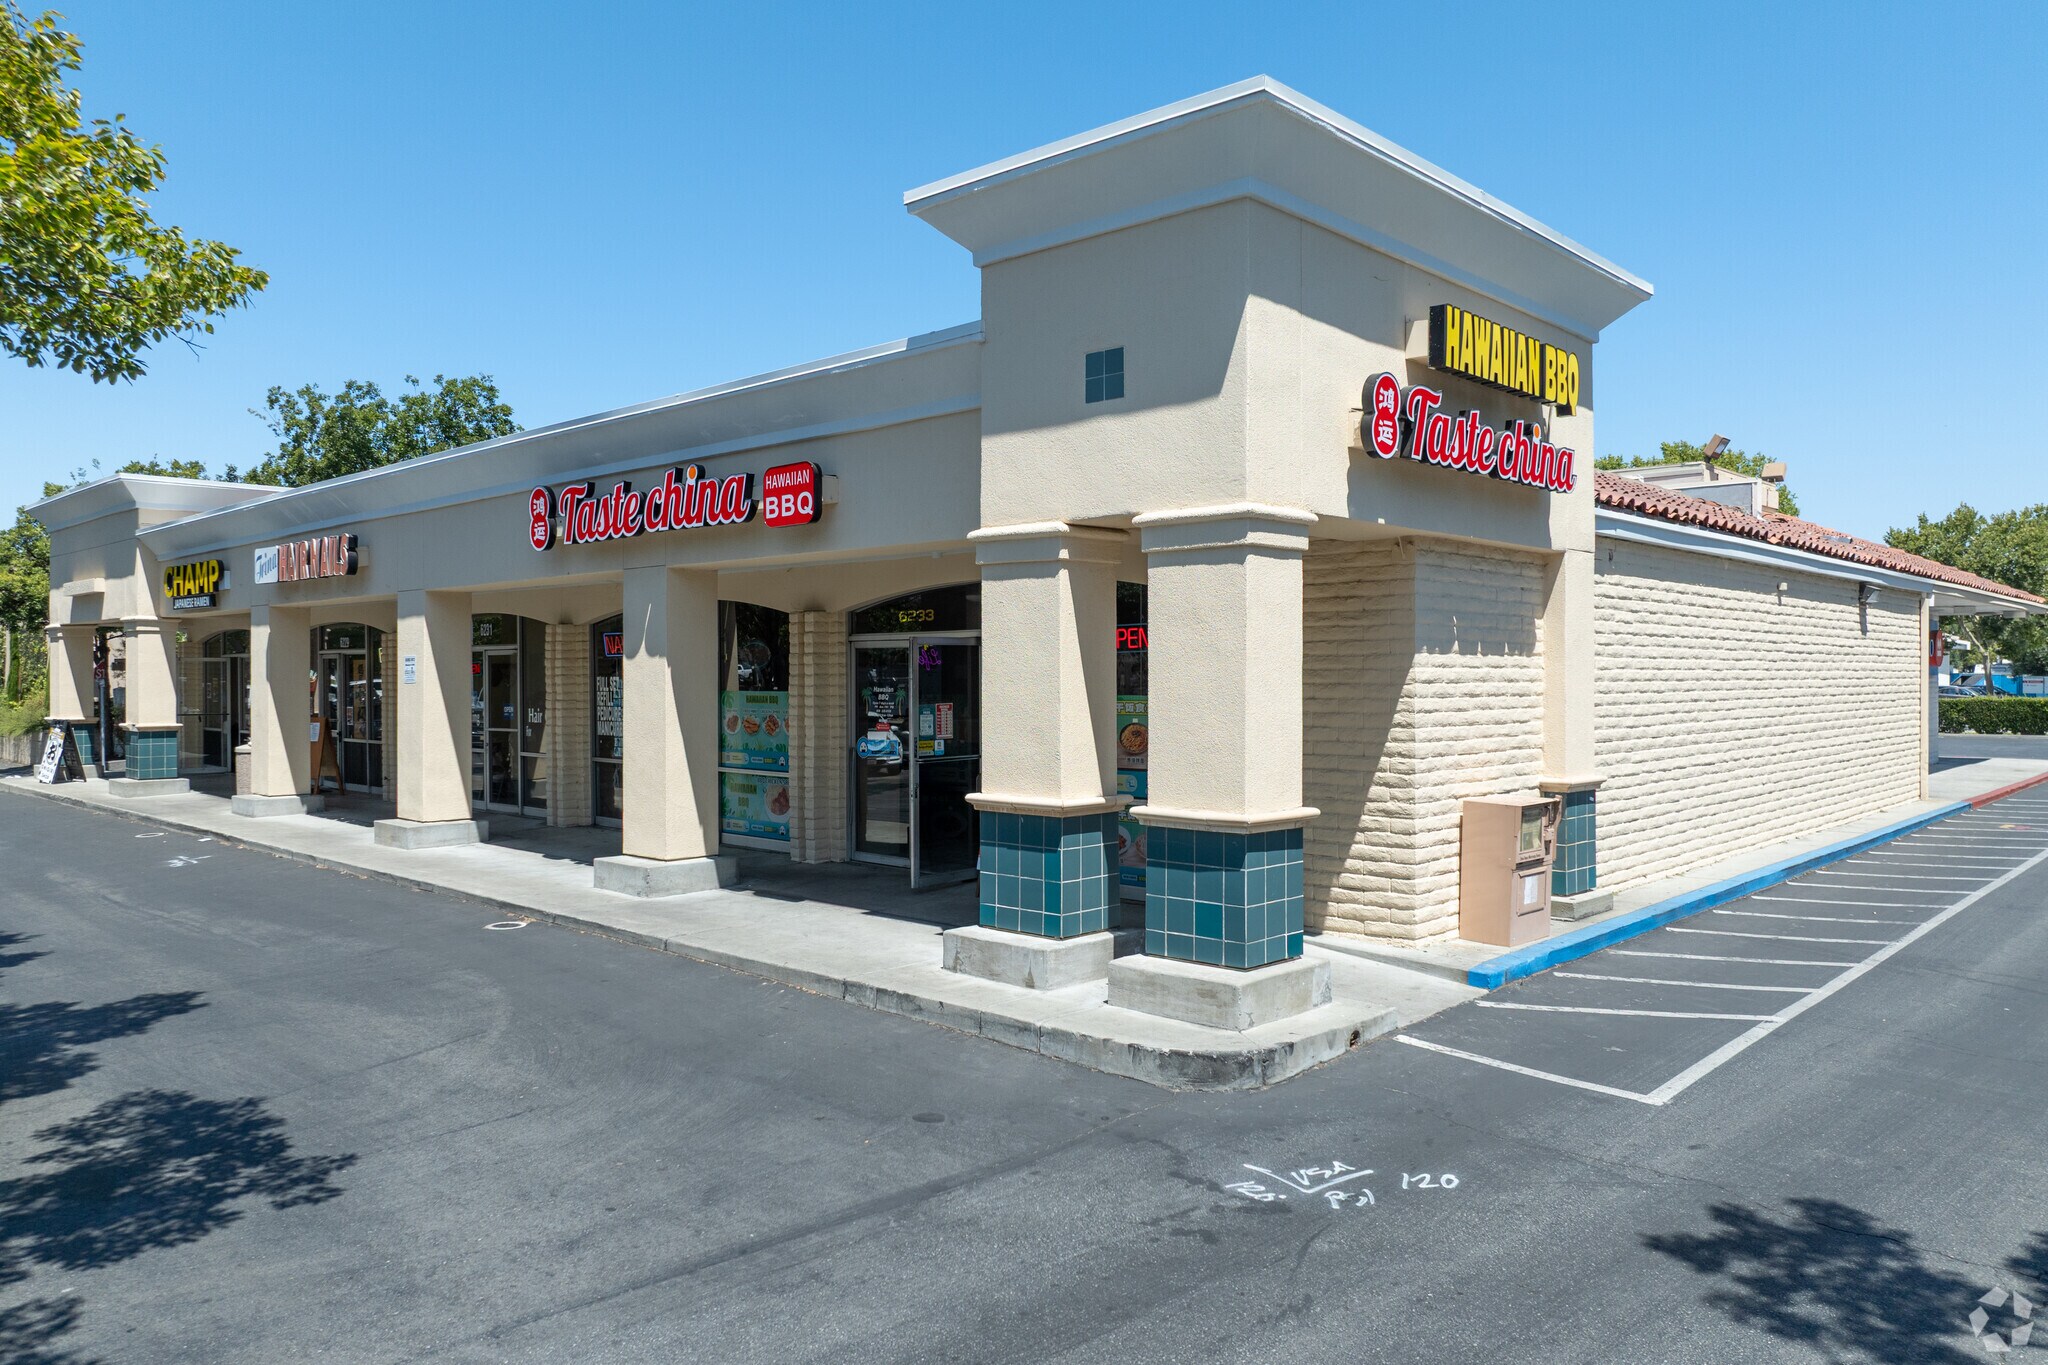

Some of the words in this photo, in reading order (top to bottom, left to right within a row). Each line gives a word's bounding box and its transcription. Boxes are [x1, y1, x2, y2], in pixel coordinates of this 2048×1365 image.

[1445, 304, 1541, 397] HAWAIIAN
[1544, 343, 1580, 416] BBQ
[1406, 384, 1497, 475] Taste
[1496, 419, 1578, 493] china
[765, 469, 810, 490] HAWAIIAN
[559, 481, 643, 545] Taste
[644, 464, 752, 533] china
[765, 491, 814, 519] BBQ
[278, 540, 310, 582] HAIR
[309, 532, 350, 579] NAILS
[163, 559, 220, 599] CHAMP
[173, 598, 194, 609] JAPANESE
[194, 596, 210, 607] RAMEN
[898, 609, 935, 623] 6233
[1116, 627, 1149, 649] PEN
[596, 676, 609, 691] FULL
[528, 708, 543, 723] Hair
[1401, 1172, 1460, 1190] 120
